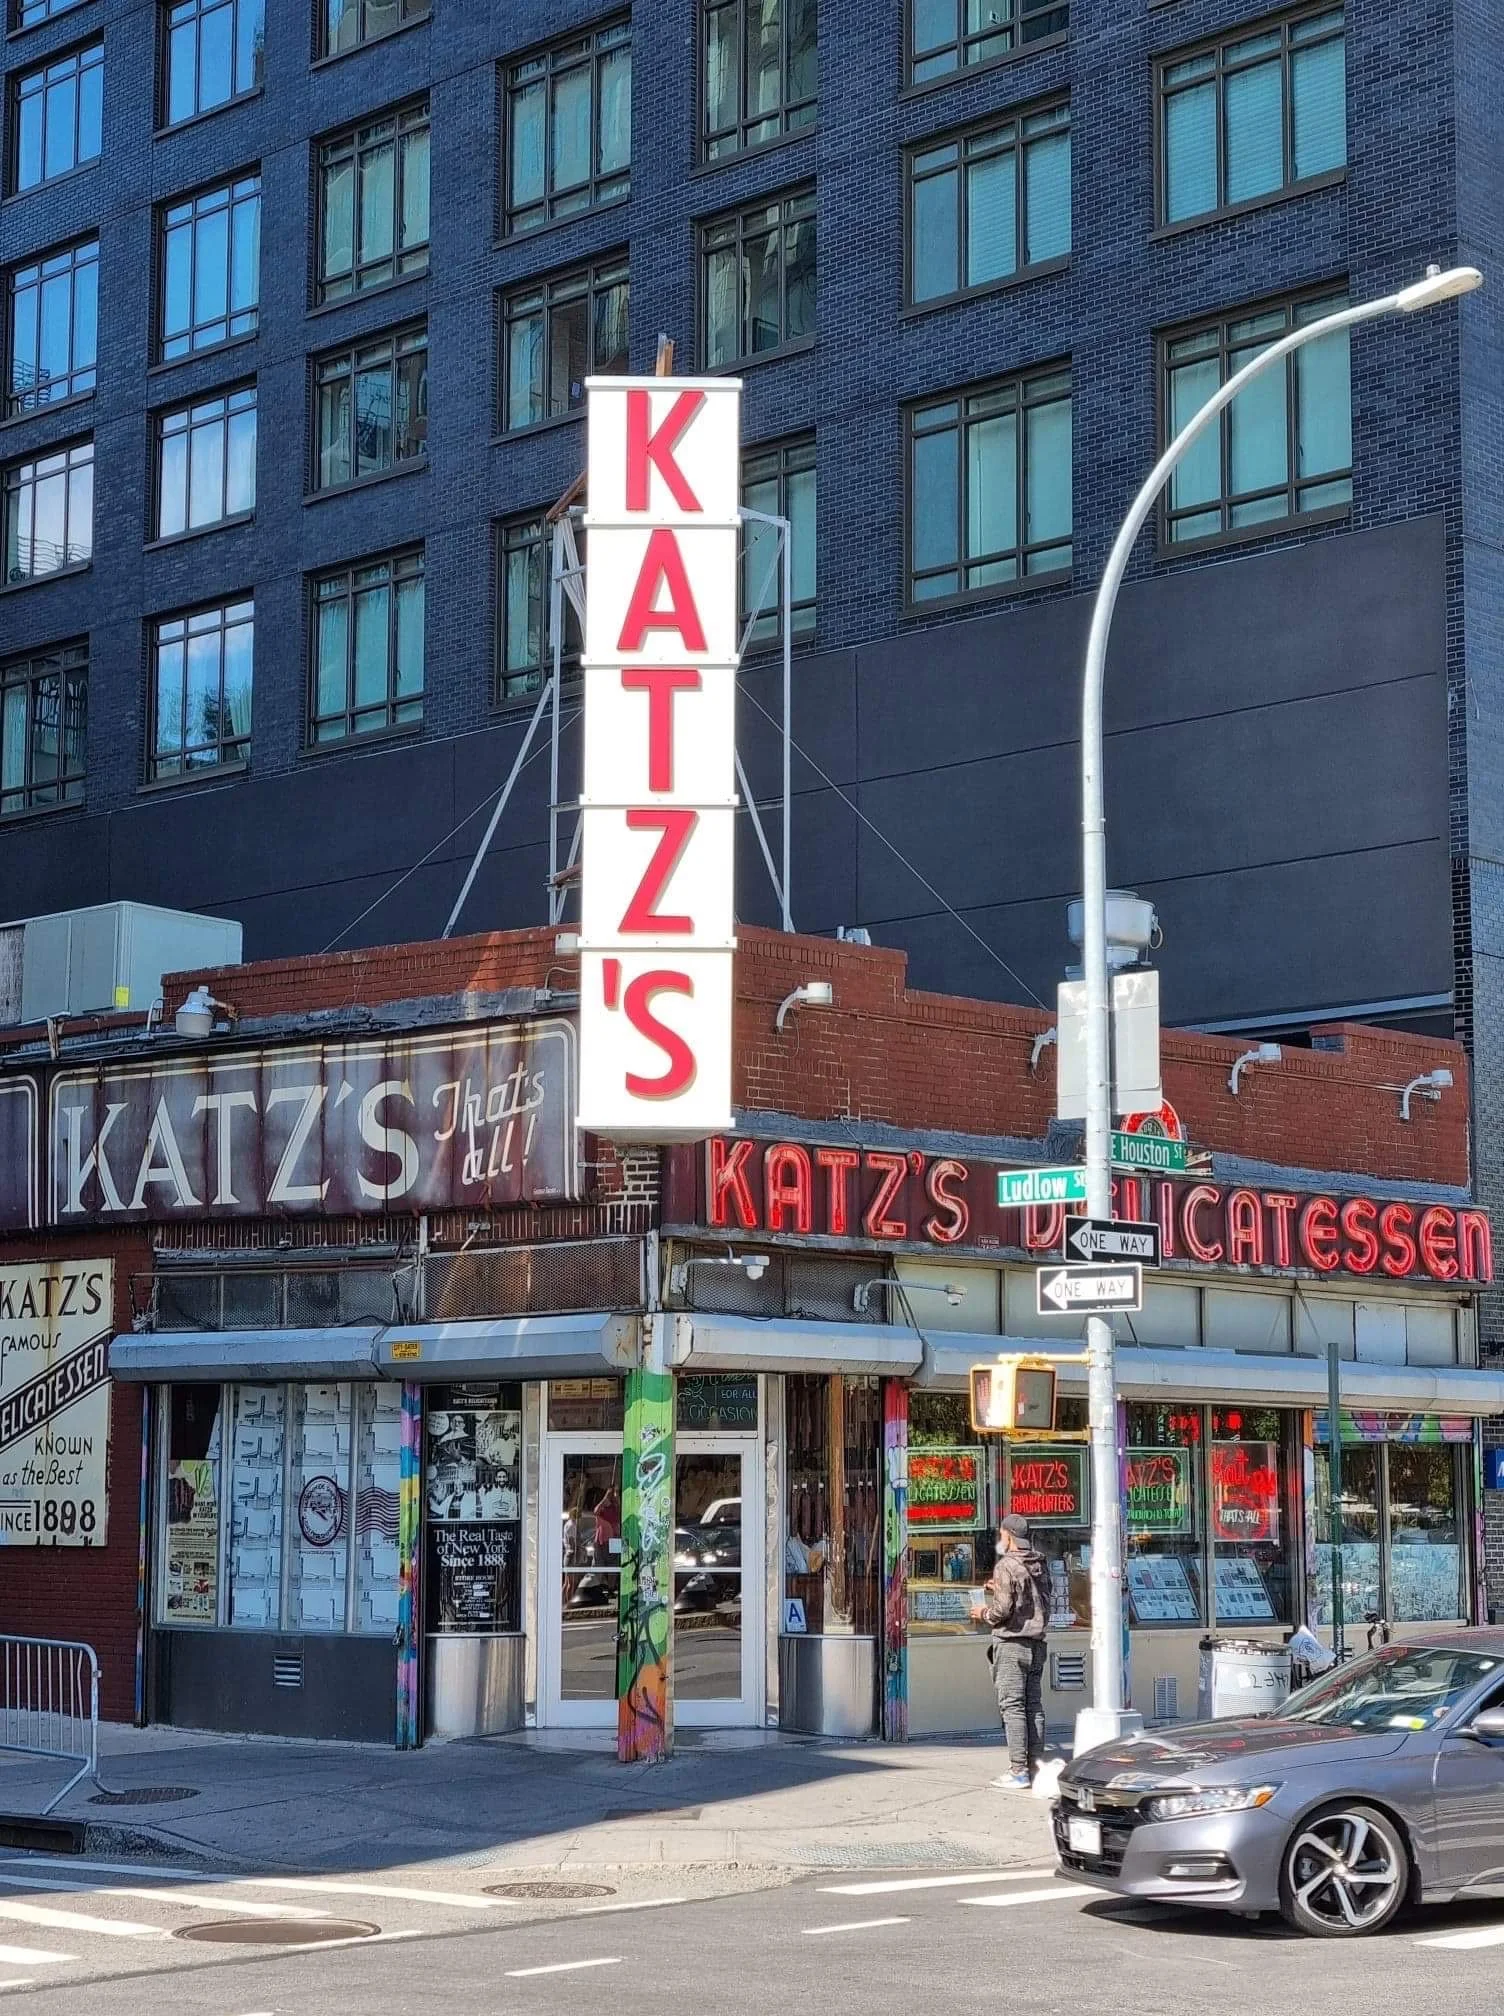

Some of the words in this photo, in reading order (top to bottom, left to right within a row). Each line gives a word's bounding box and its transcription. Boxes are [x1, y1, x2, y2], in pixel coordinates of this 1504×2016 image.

[602, 389, 707, 1101] KATZ'S
[433, 1062, 545, 1141] That's
[61, 1079, 420, 1213] KATZ'S
[1121, 1136, 1170, 1166] Houston
[1174, 1144, 1183, 1159] St
[1002, 1174, 1068, 1201] Ludlow
[709, 1135, 970, 1243] KATZ'S
[1025, 1178, 1494, 1282] DICATESSEN
[1080, 1232, 1107, 1250] ONE
[1120, 1235, 1148, 1254] WAY
[0, 1271, 104, 1319] KATZ'S
[1054, 1282, 1082, 1298] ONE
[1096, 1281, 1126, 1297] WAY
[0, 1343, 105, 1443] ELICATESSEN
[34, 1432, 93, 1456] KNOWN
[3, 1472, 18, 1486] as
[21, 1459, 45, 1485] the
[45, 1459, 83, 1486] Best
[1012, 1461, 1069, 1489] KATZ'S
[1125, 1456, 1176, 1488] ATZ'S
[0, 1512, 32, 1533] INCE
[434, 1529, 457, 1542] The
[459, 1529, 485, 1542] Real
[487, 1529, 513, 1541] Taste
[437, 1542, 450, 1555] of
[452, 1542, 480, 1555] New
[483, 1541, 510, 1554] York.
[441, 1554, 475, 1567] Since
[788, 1602, 801, 1623] A
